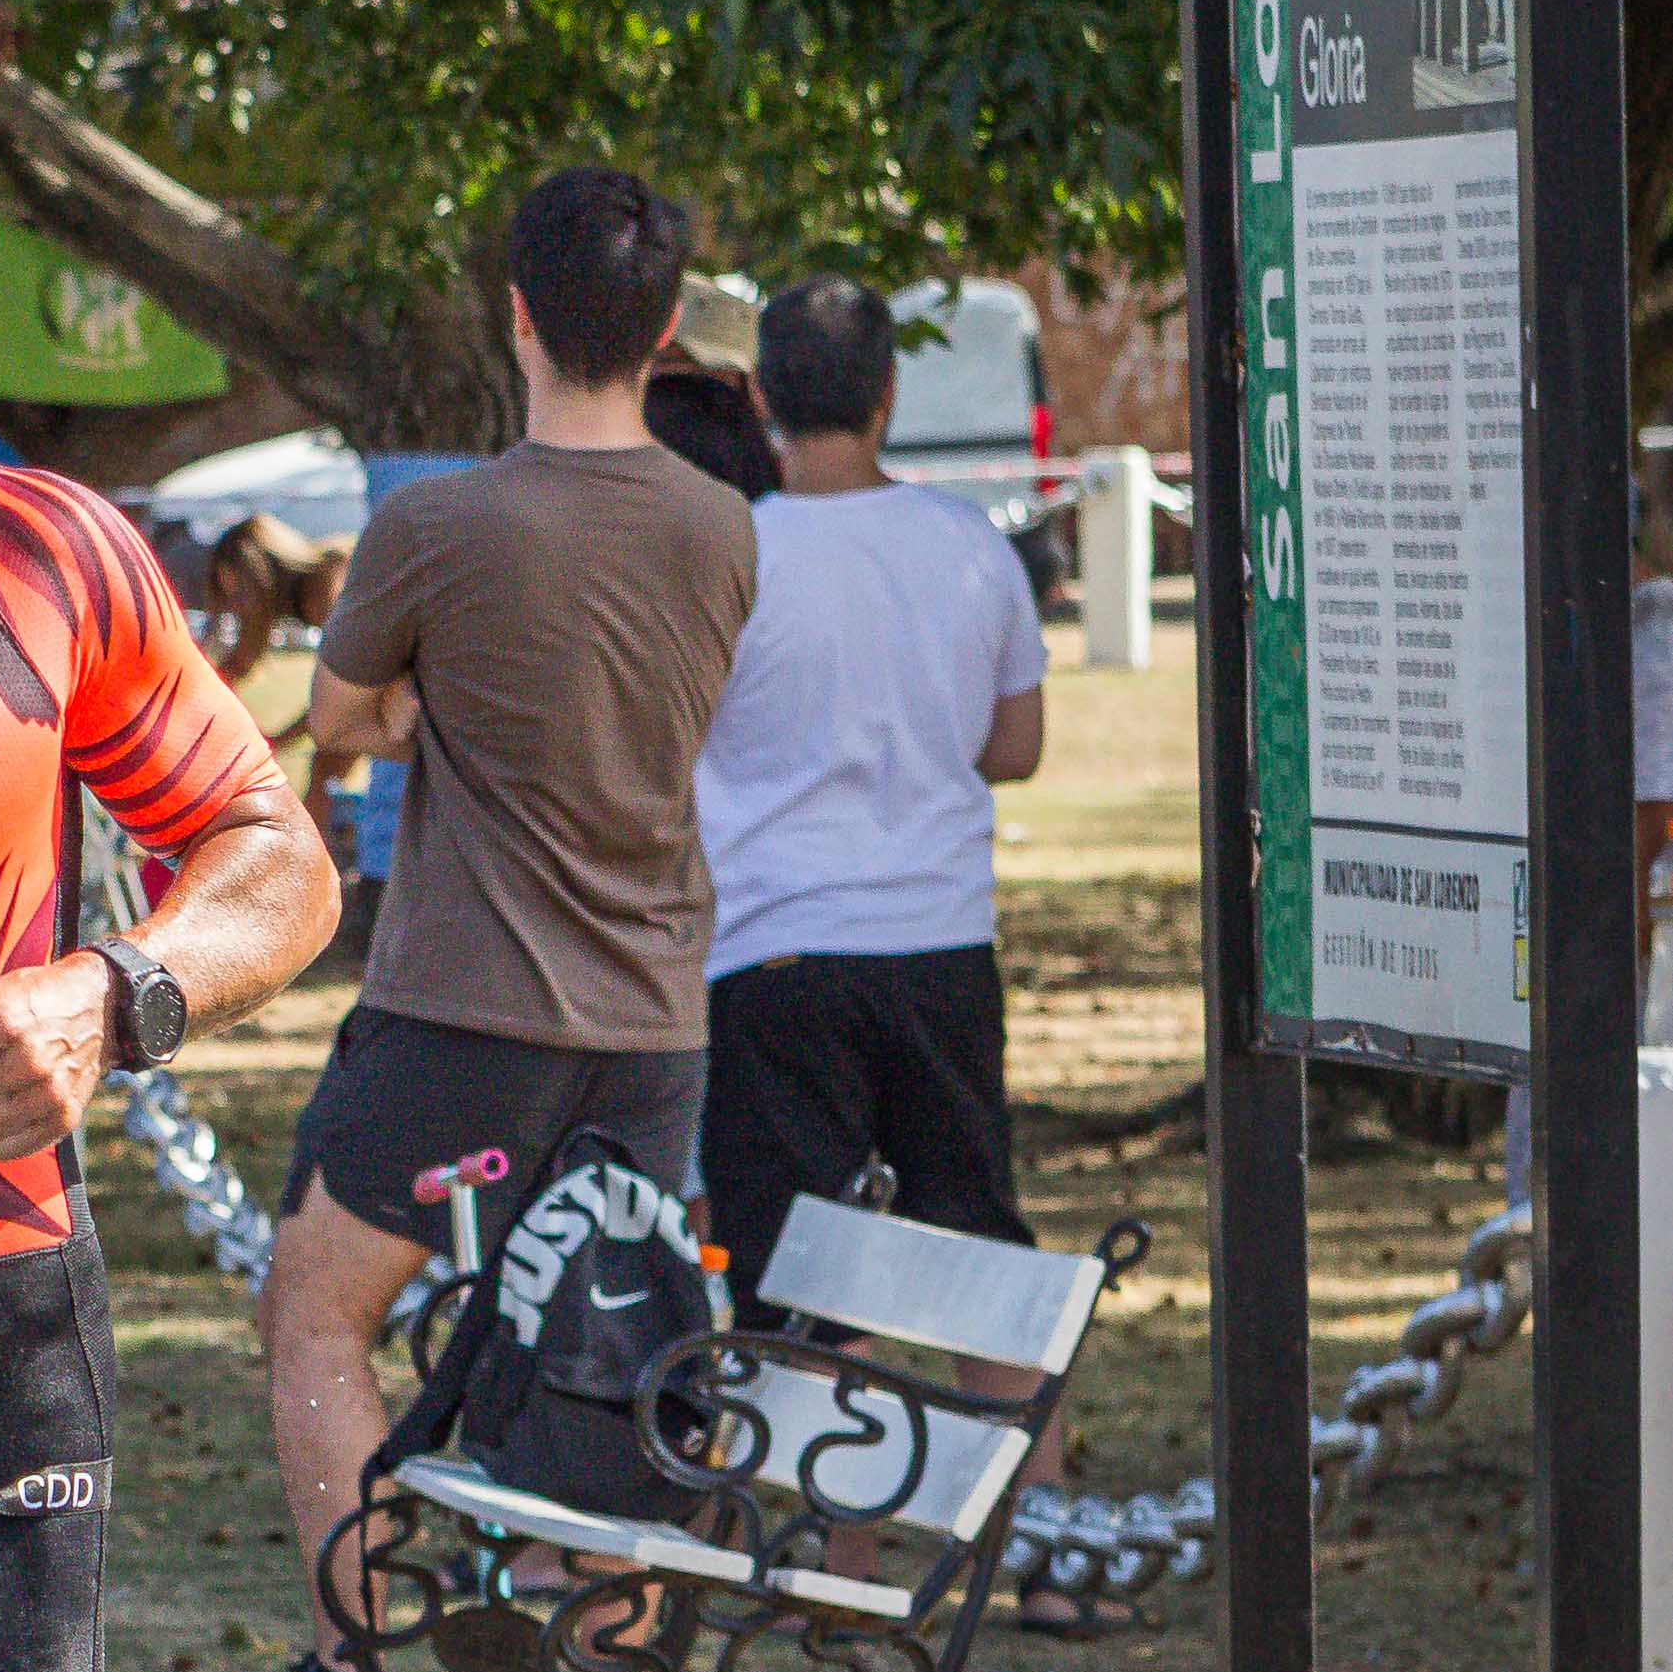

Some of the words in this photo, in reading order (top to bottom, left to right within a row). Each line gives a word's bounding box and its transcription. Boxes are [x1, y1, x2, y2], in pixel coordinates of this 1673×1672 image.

[1299, 14, 1367, 108] Gloria
[1262, 267, 1295, 601] San
[1324, 860, 1397, 902] MUNICIPALIDAD
[1400, 866, 1412, 905] DE
[1414, 868, 1432, 909] SAN
[1434, 871, 1479, 913] LORENZO
[499, 1163, 607, 1349] JUST
[17, 1473, 94, 1509] CDD
